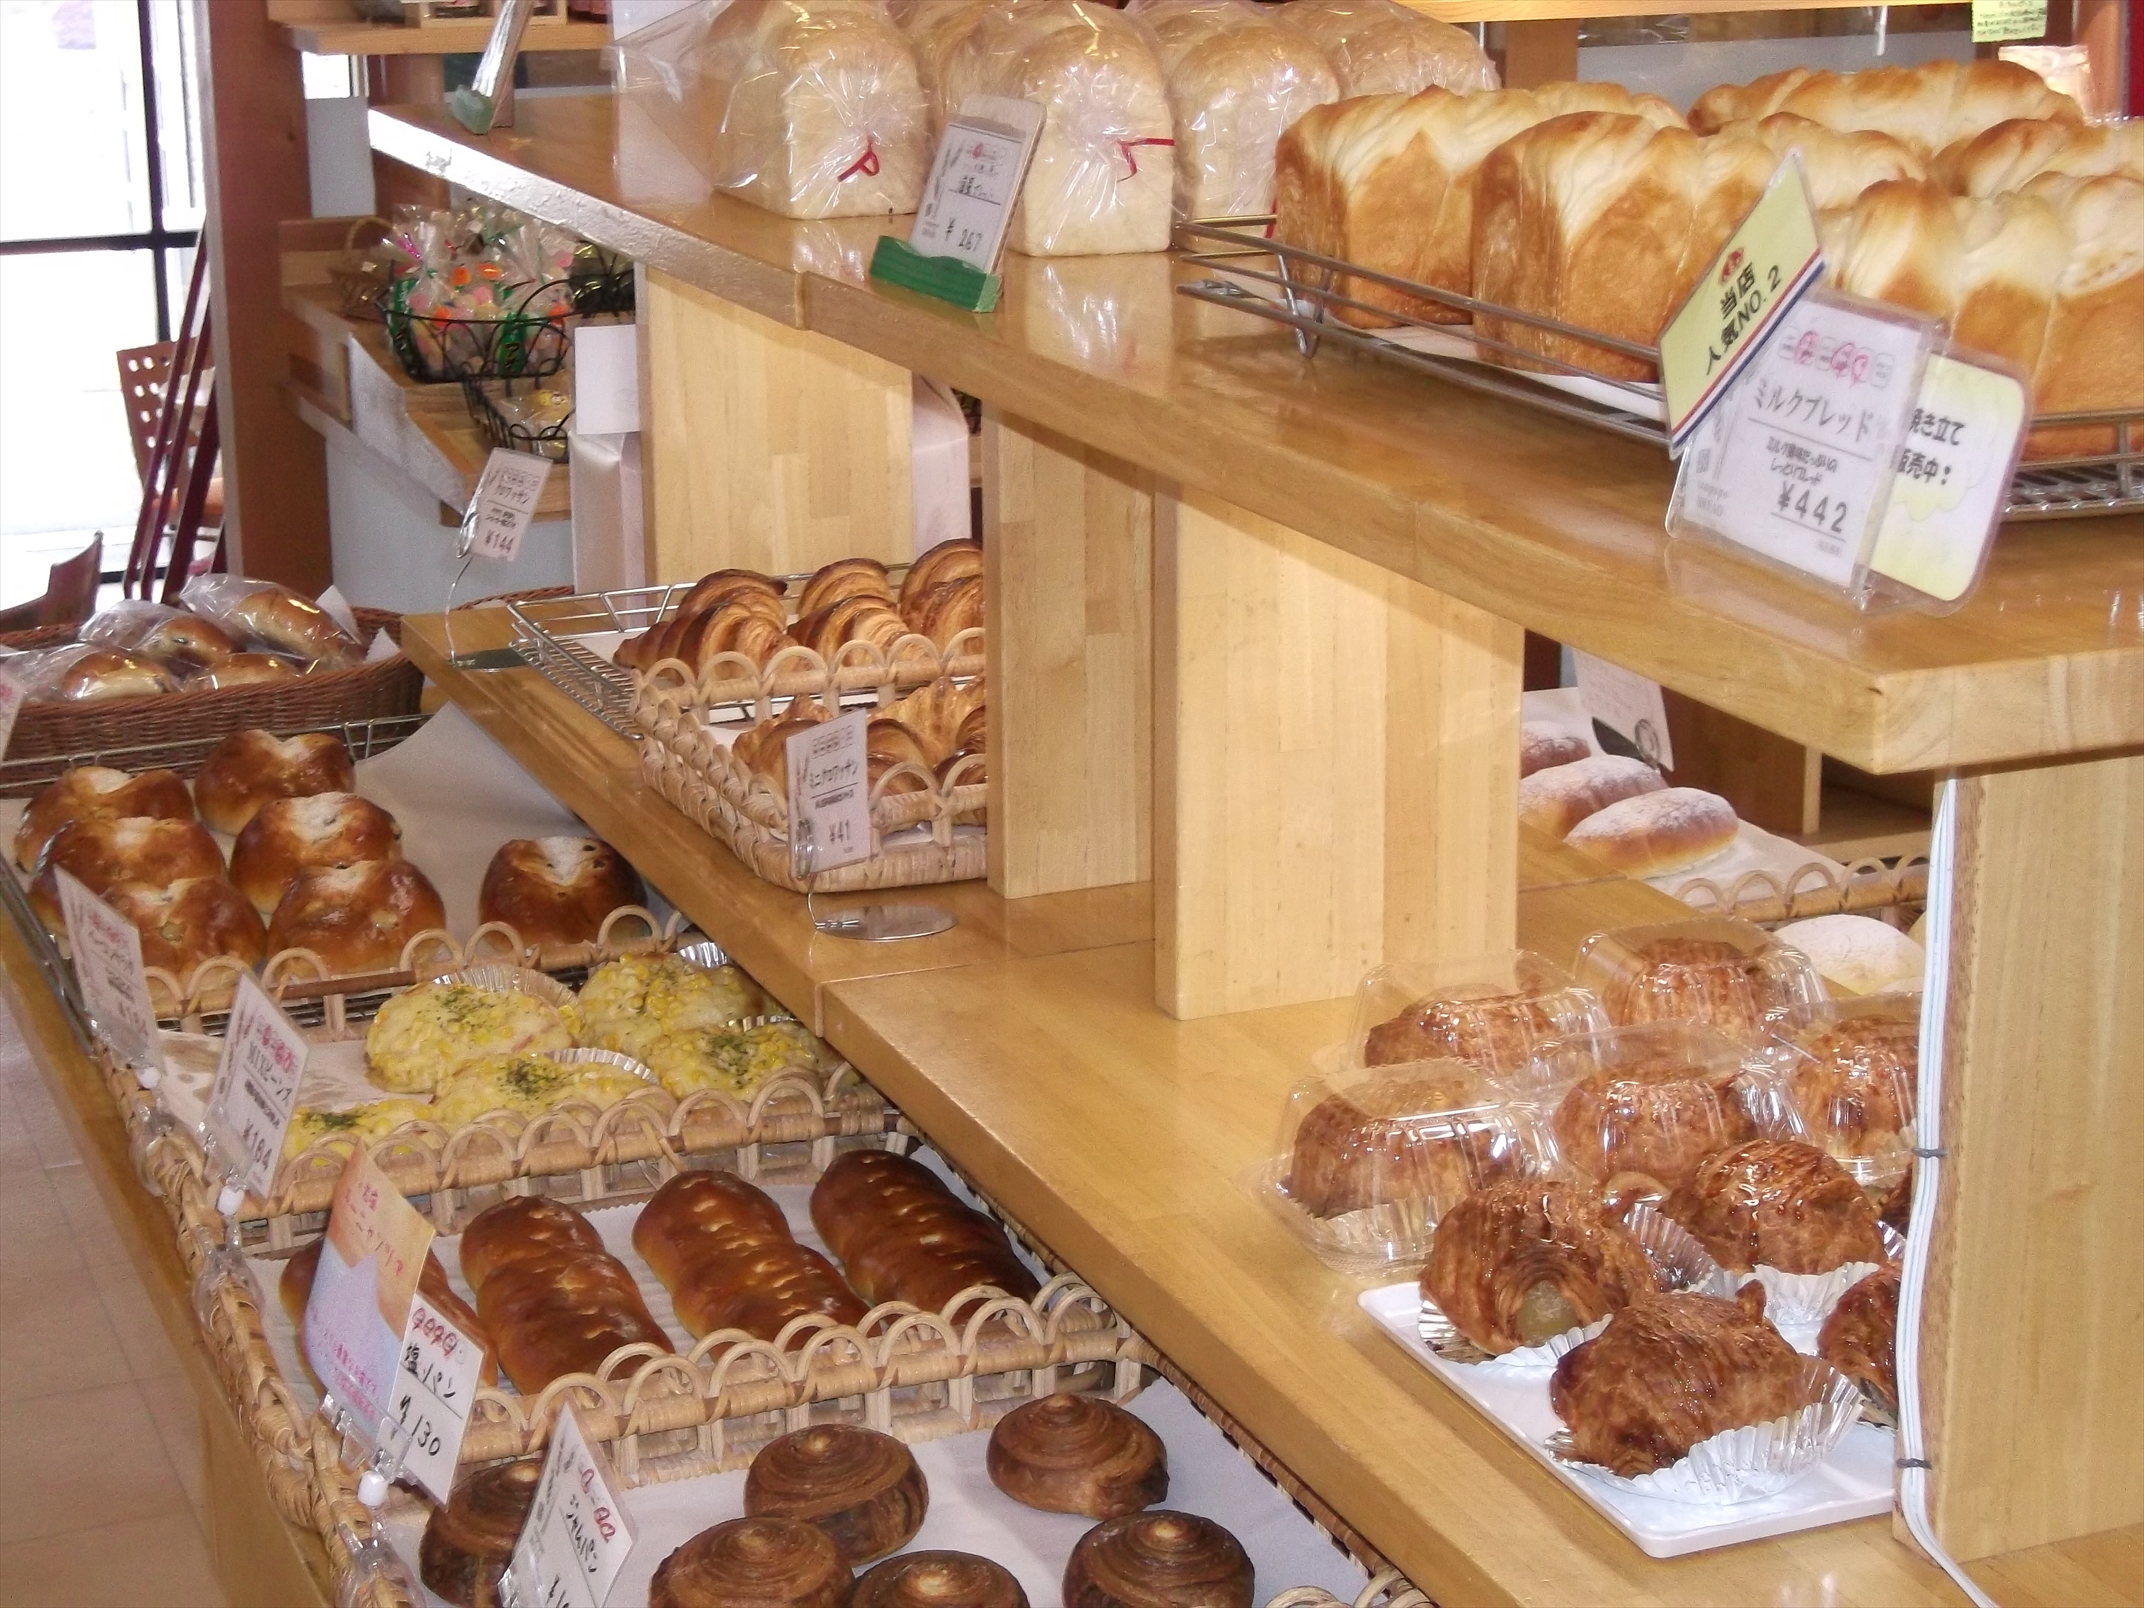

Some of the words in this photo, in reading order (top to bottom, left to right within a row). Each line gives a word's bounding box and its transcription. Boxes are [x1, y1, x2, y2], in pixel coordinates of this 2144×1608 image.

[1720, 261, 1755, 320] 当店
[1754, 379, 1873, 442] ミルクブレッド
[1778, 480, 1848, 534] ¥442
[829, 819, 851, 845] ¥41
[404, 1341, 457, 1399] 塩パン
[391, 1394, 441, 1457] ¥130
